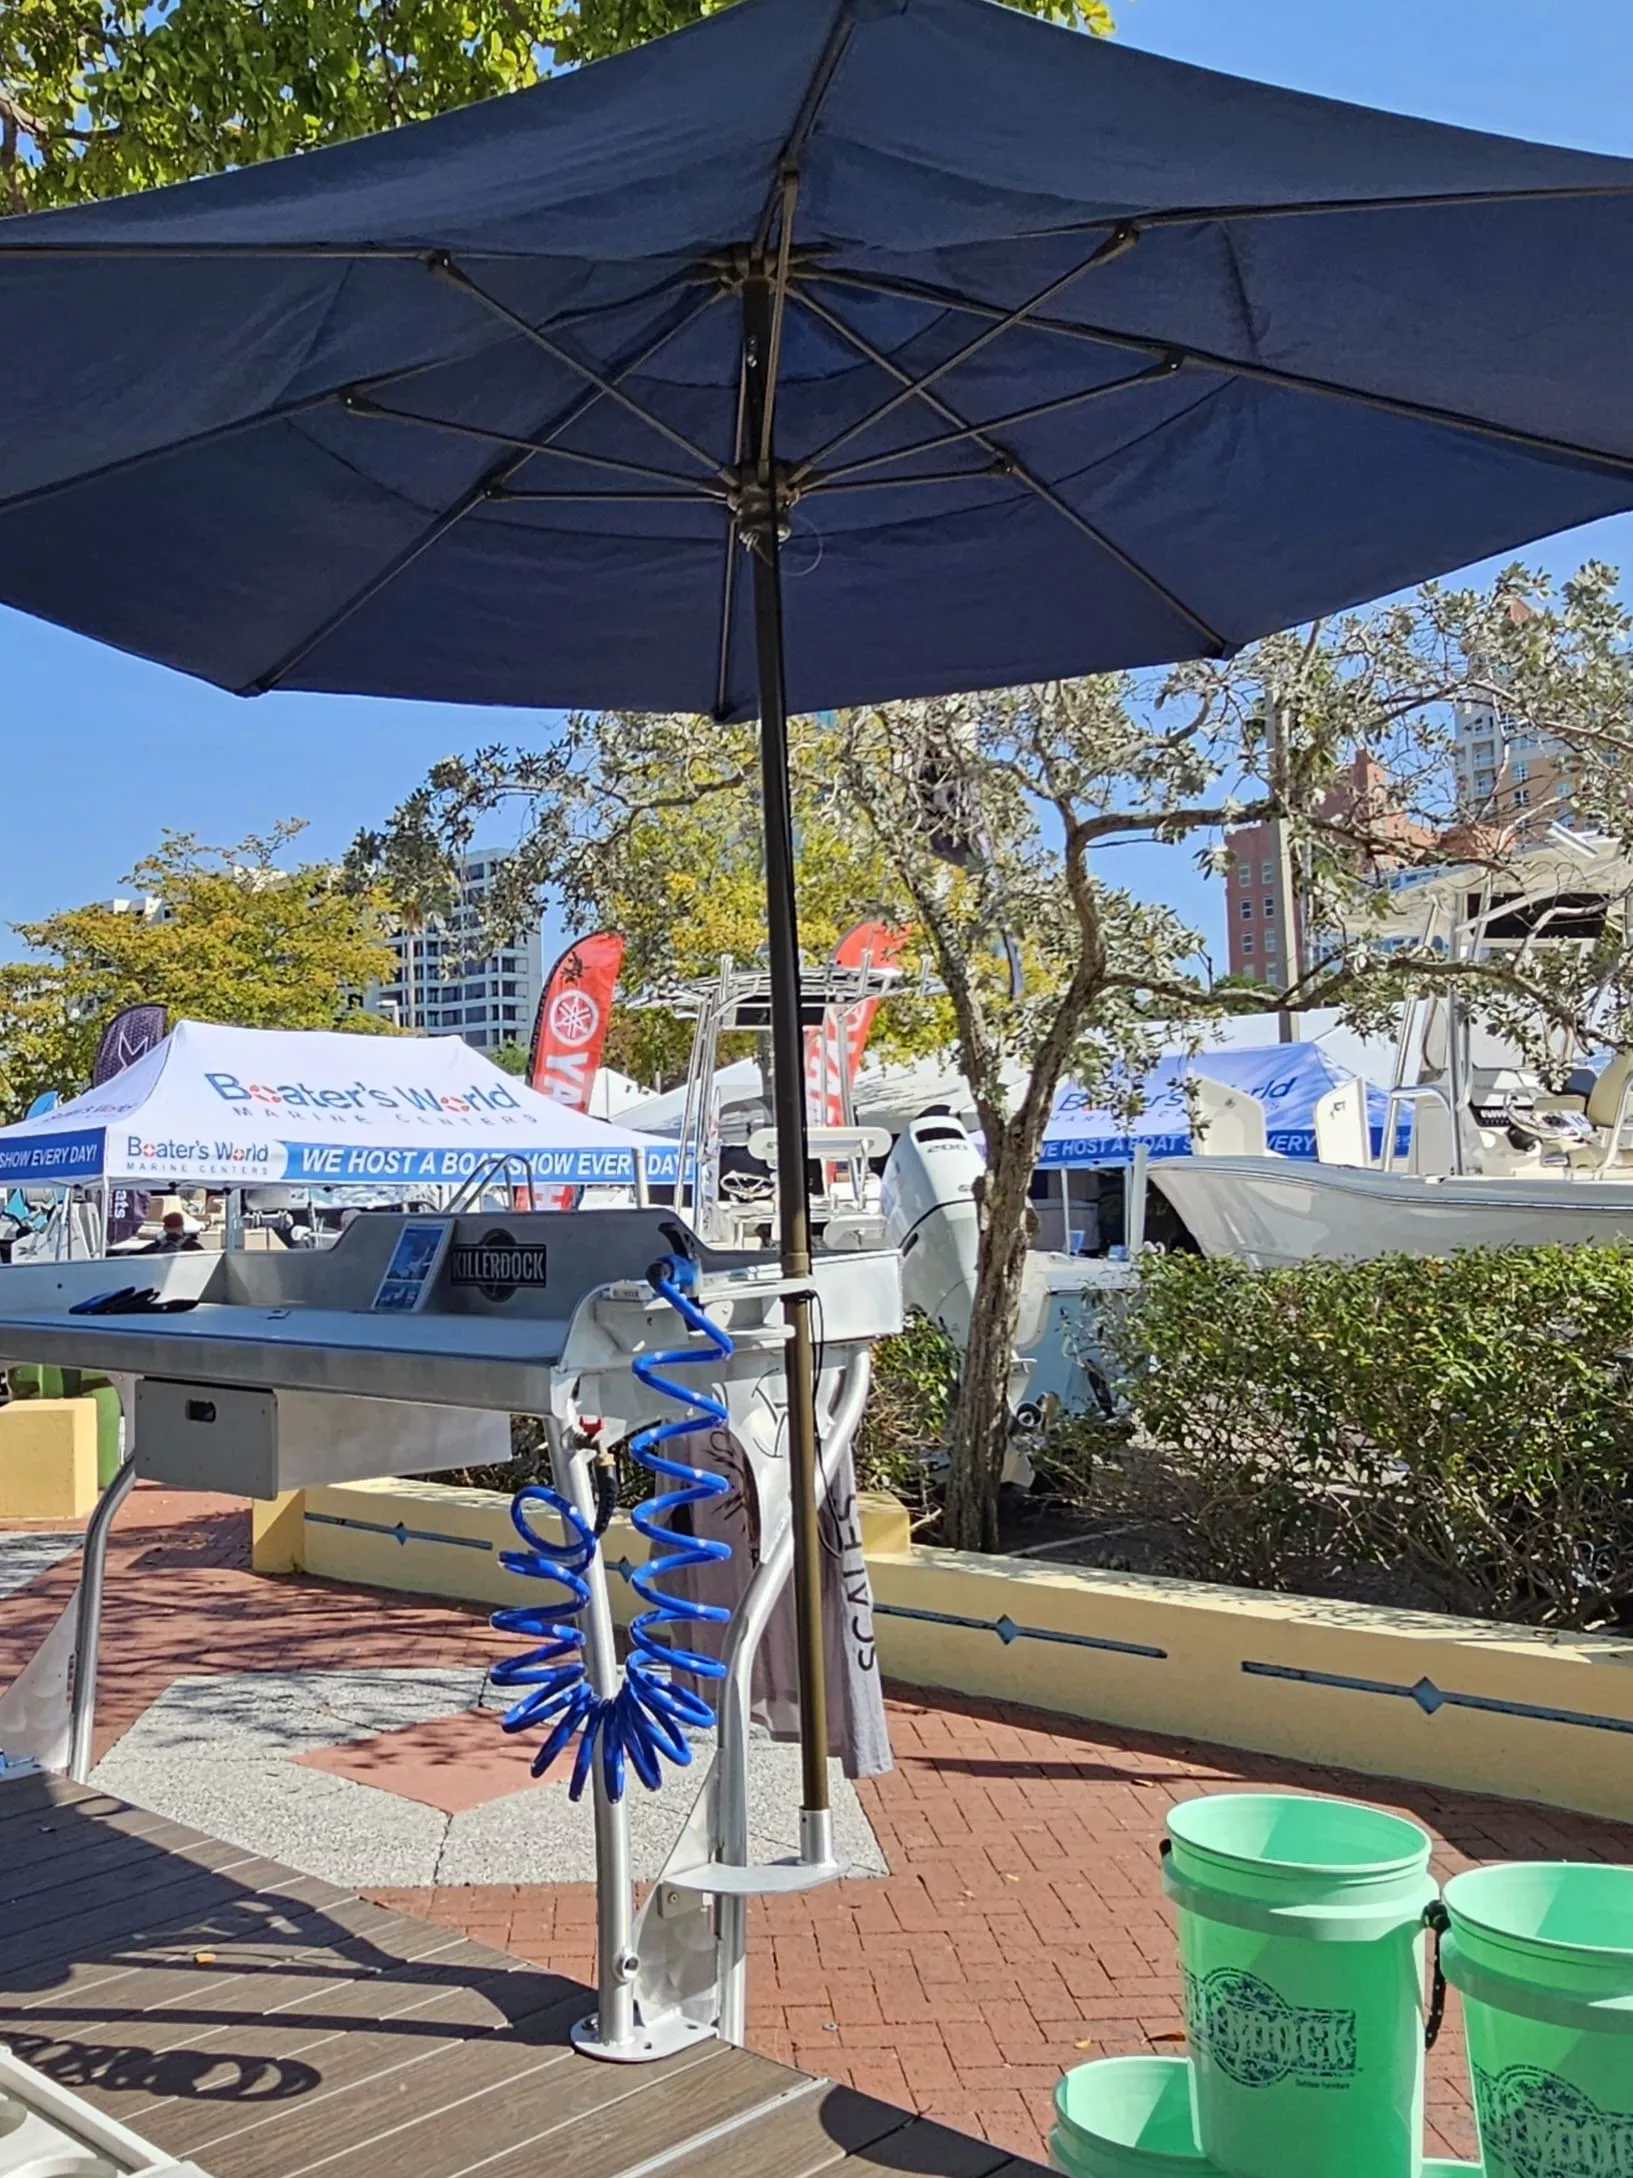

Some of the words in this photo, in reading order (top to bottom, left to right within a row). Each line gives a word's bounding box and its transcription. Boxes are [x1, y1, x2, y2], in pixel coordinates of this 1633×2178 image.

[203, 1073, 399, 1110] Boater's
[393, 1083, 521, 1112] World
[0, 1150, 32, 1168] SHOW
[31, 1146, 70, 1166] EVERY
[127, 1136, 209, 1160] Boater's
[215, 1141, 269, 1162] World
[1061, 1138, 1108, 1157] HOST
[1110, 1136, 1125, 1153] A
[302, 1147, 345, 1173] WE
[347, 1150, 418, 1174] HOST
[418, 1152, 437, 1175] A
[510, 1152, 575, 1176] SHOW
[577, 1153, 633, 1176] EVER
[452, 1251, 545, 1280] KILLERDOCK
